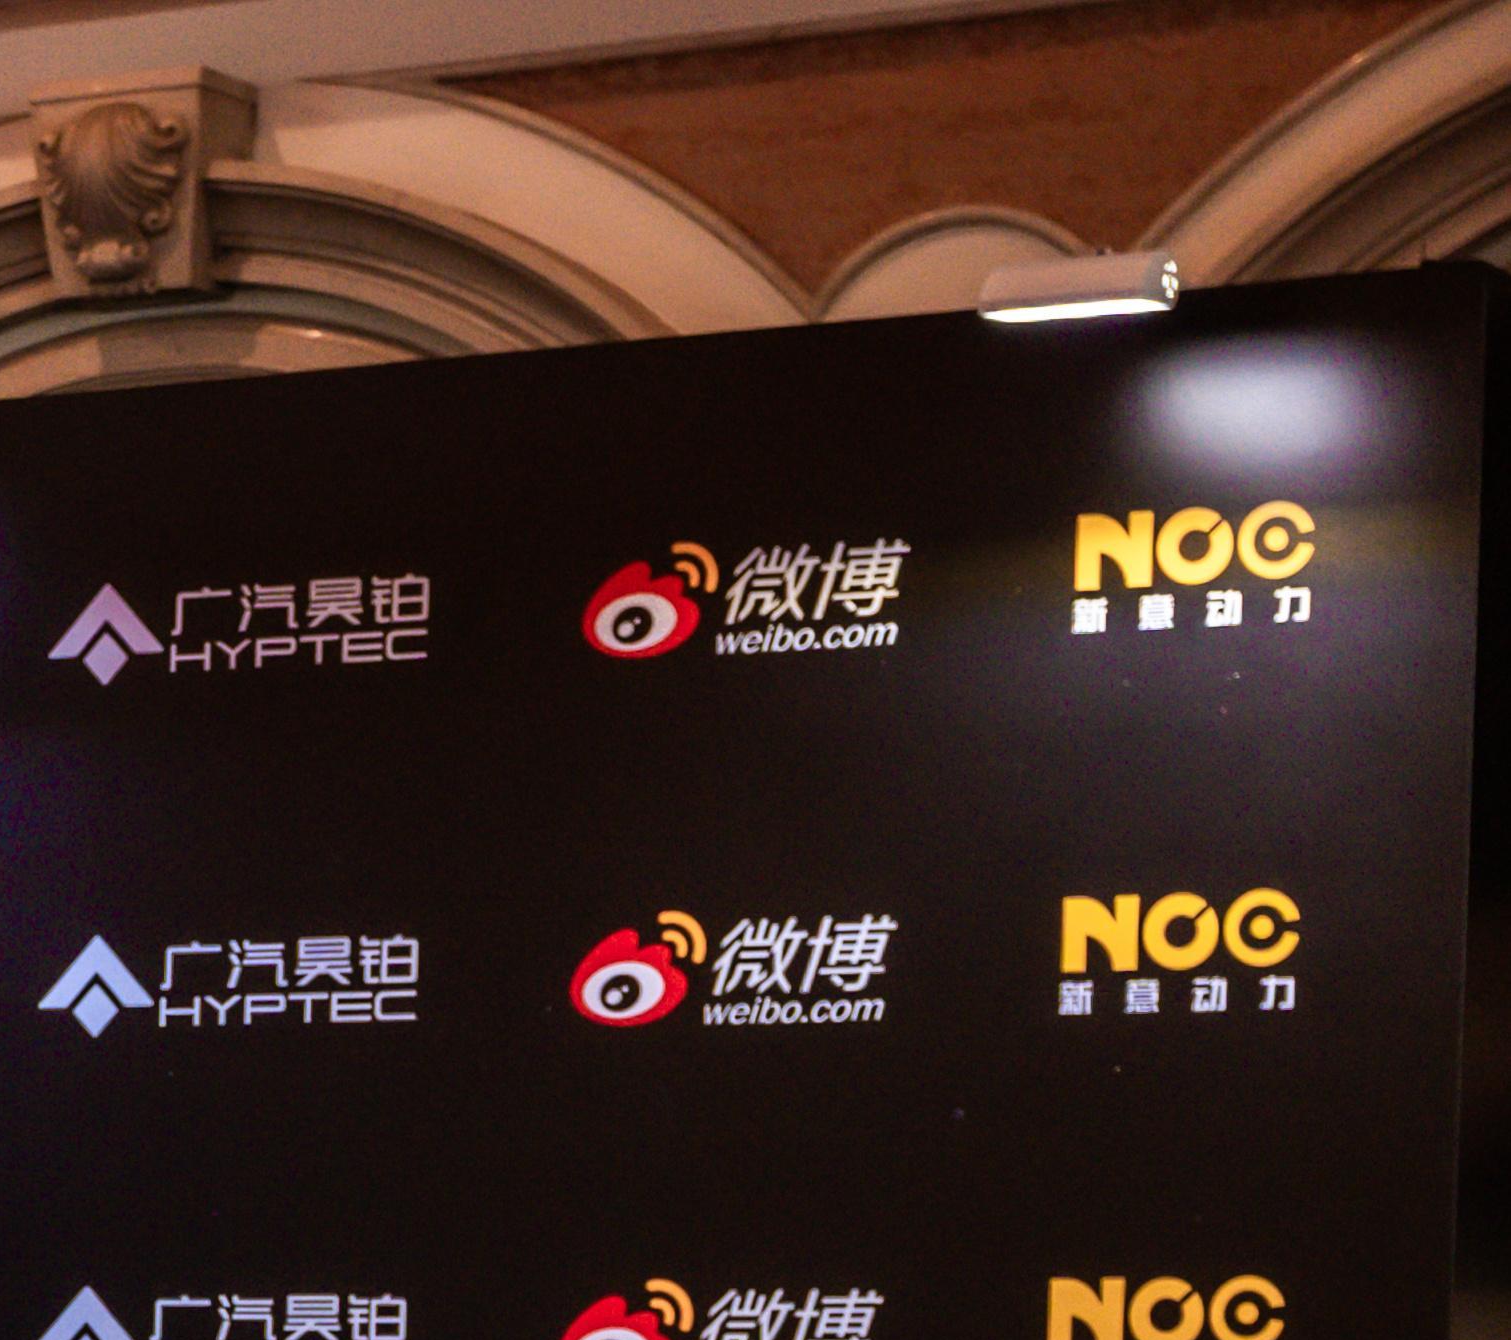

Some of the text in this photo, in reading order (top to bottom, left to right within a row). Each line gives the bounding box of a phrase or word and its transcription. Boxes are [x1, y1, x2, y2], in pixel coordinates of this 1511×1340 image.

[1075, 501, 1315, 591] NOC
[171, 573, 430, 636] 广汽昊铂
[726, 539, 911, 624] 微博
[1072, 586, 1311, 634] 新意动力
[170, 628, 428, 672] HYPTEC
[716, 622, 898, 654] weibo.com
[713, 914, 898, 995] 微博
[1062, 888, 1300, 972] NOC
[160, 935, 419, 990] 广汽昊铂
[703, 996, 884, 1025] weibo.com
[1060, 975, 1295, 1014] 新意动力
